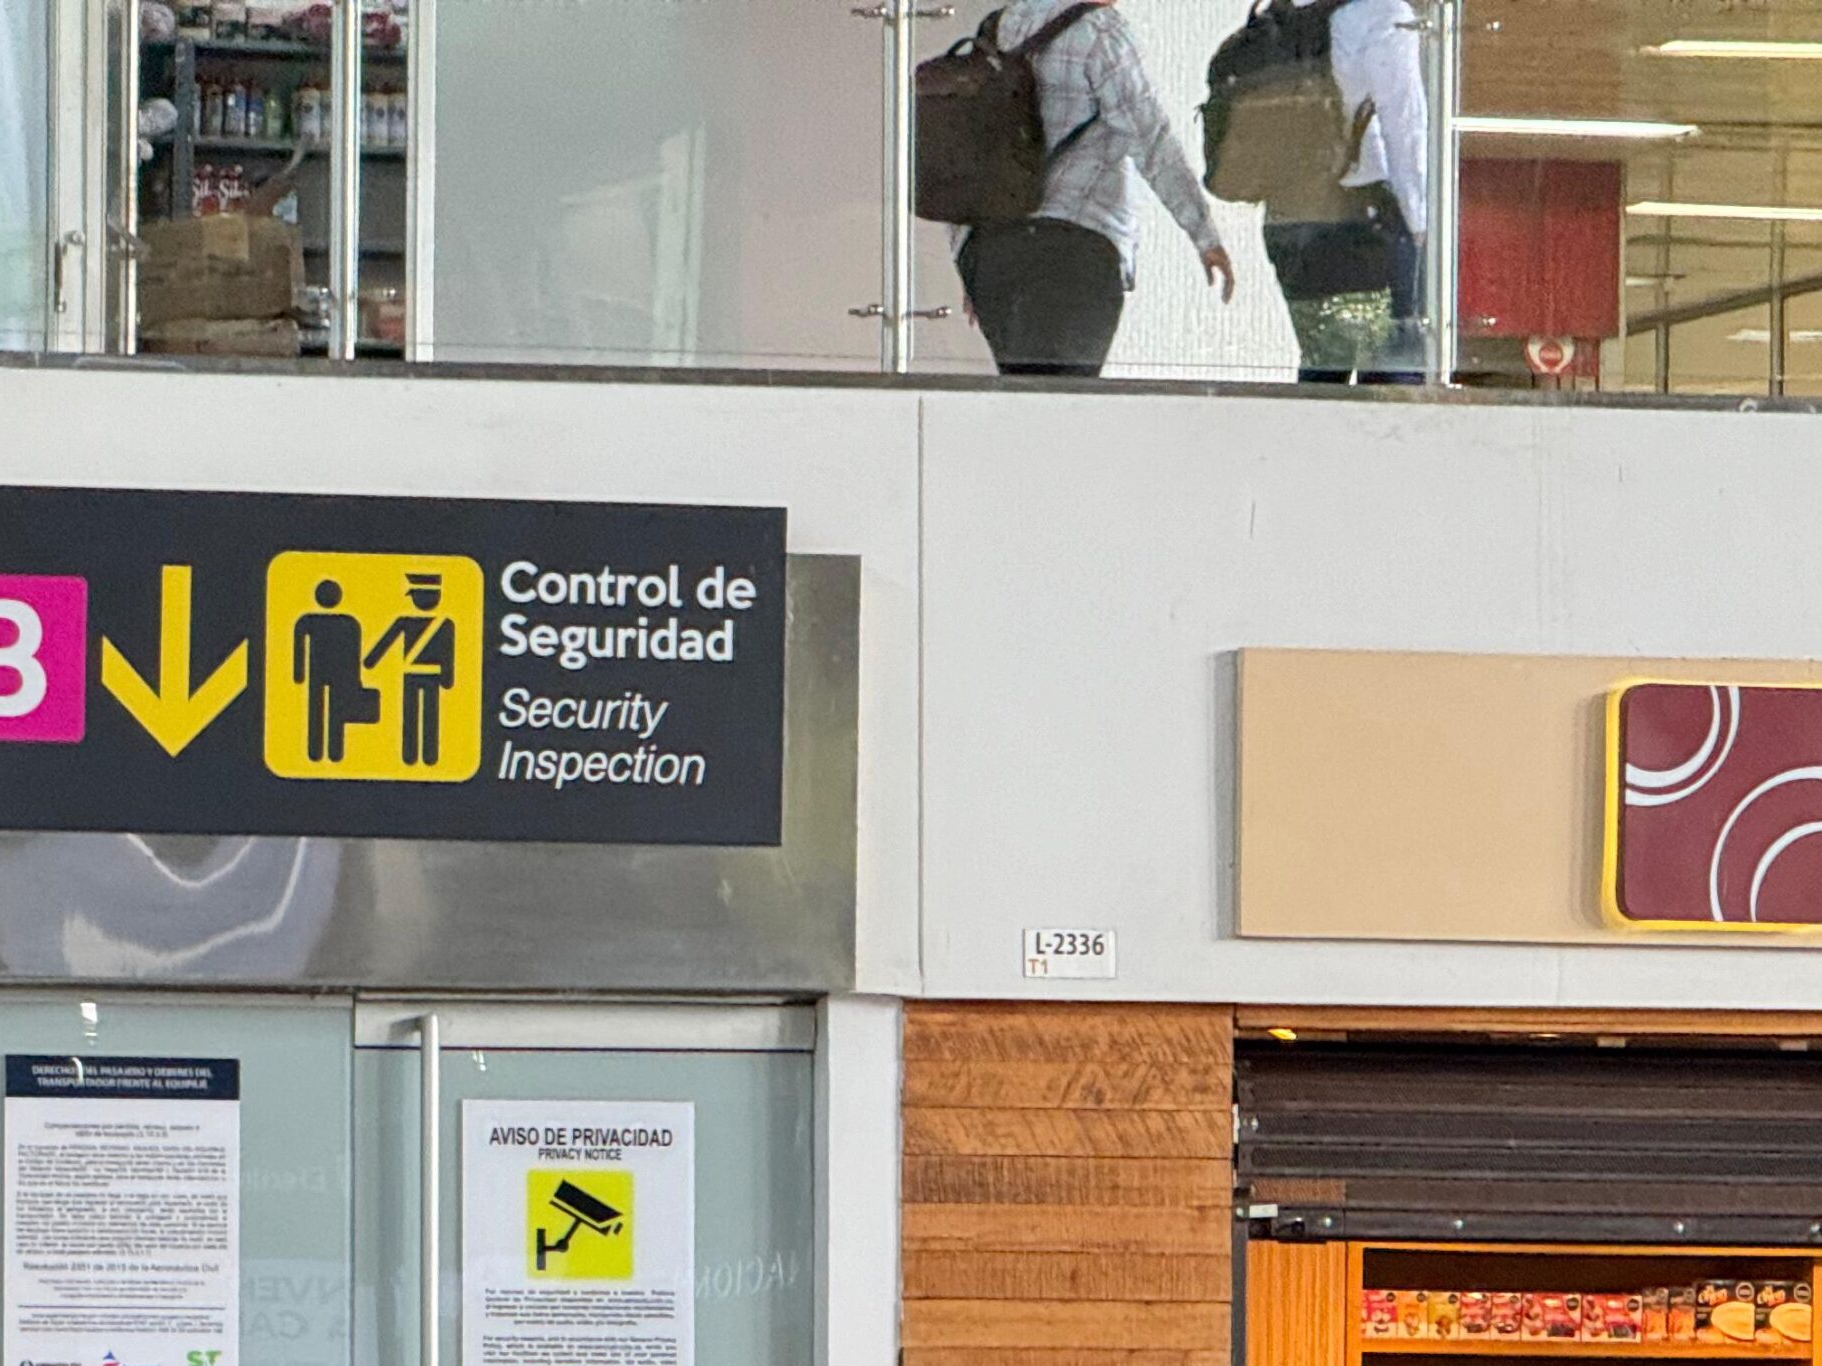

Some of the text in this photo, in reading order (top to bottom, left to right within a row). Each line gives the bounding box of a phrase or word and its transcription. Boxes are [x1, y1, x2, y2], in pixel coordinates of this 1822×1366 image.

[500, 561, 758, 610] Control de
[499, 613, 735, 670] Seguridad
[498, 687, 669, 740] Security
[498, 740, 707, 790] Inspection
[1035, 932, 1105, 956] L-2336
[1028, 958, 1048, 975] T1
[489, 1127, 674, 1147] AVISO DE PRIVACIDAD
[538, 1148, 622, 1161] PRIVACY NOTICE
